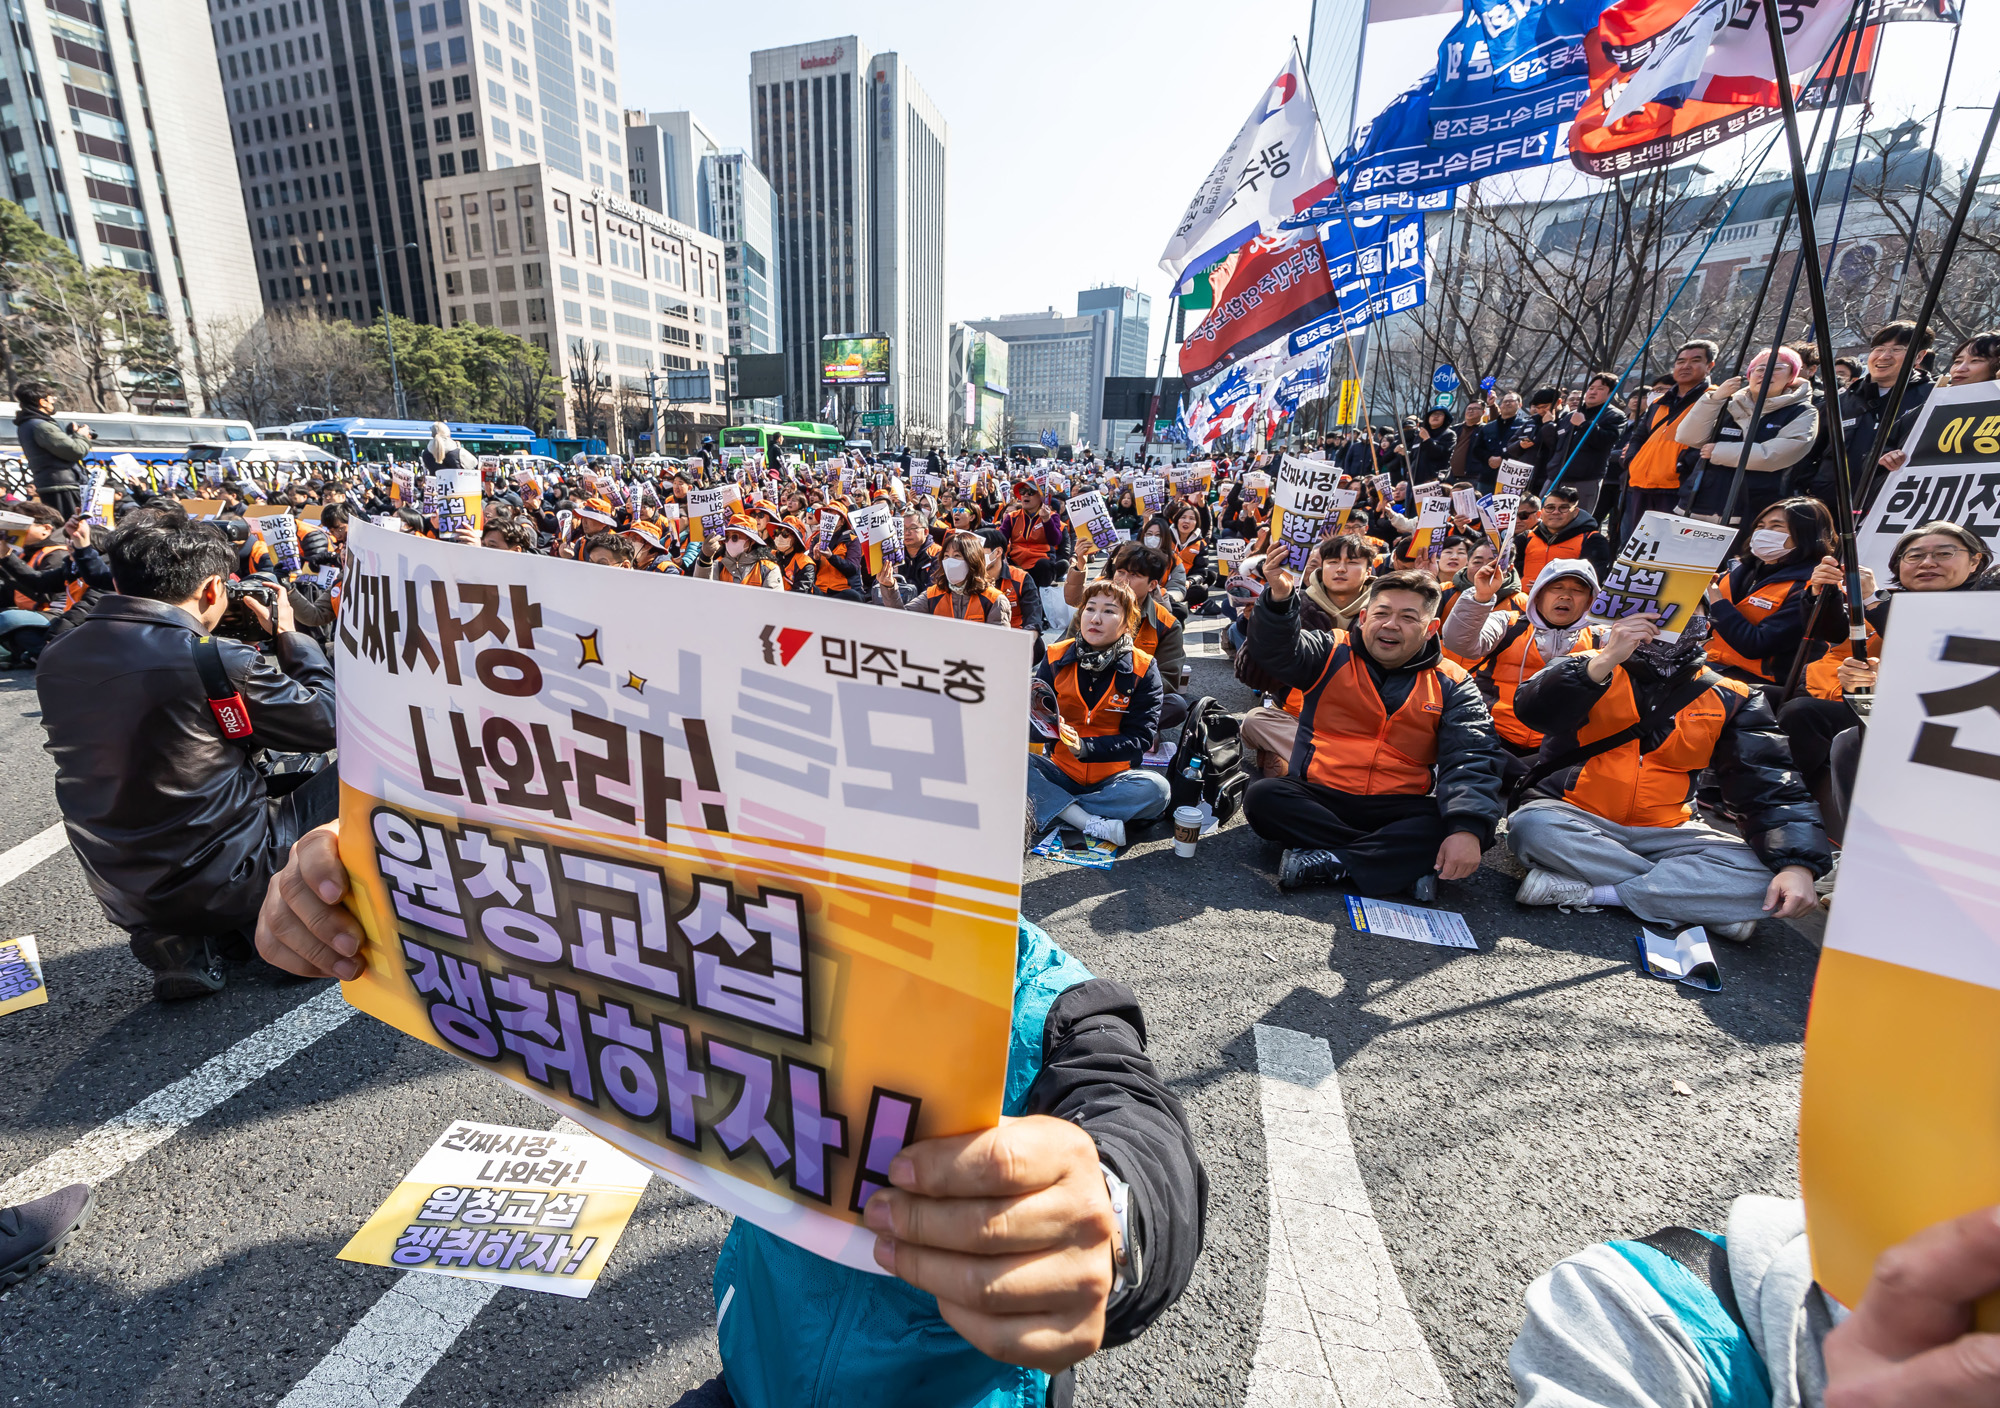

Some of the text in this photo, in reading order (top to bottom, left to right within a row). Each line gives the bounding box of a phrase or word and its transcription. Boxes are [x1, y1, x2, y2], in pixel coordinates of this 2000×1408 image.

[611, 196, 638, 220] SEOUL
[313, 433, 333, 443] 150
[1938, 416, 1976, 454] 이
[1280, 459, 1337, 492] 진짜사장
[1294, 491, 1329, 514] 나와
[1622, 536, 1661, 562] 라!
[1692, 529, 1727, 542] 민주노총
[1604, 561, 1665, 596] 교섭
[341, 547, 543, 698] 진짜사장
[821, 633, 986, 706] 민주노총
[218, 705, 241, 735] PRESS
[407, 703, 729, 843] 나와라!
[371, 805, 810, 1042] 원청교섭
[402, 937, 920, 1213] 쟁취하자!
[441, 1126, 557, 1158] 진짜사장
[476, 1159, 588, 1187] 나와라!
[416, 1185, 589, 1229] 원청교섭
[390, 1224, 598, 1276] 쟁취하자!
